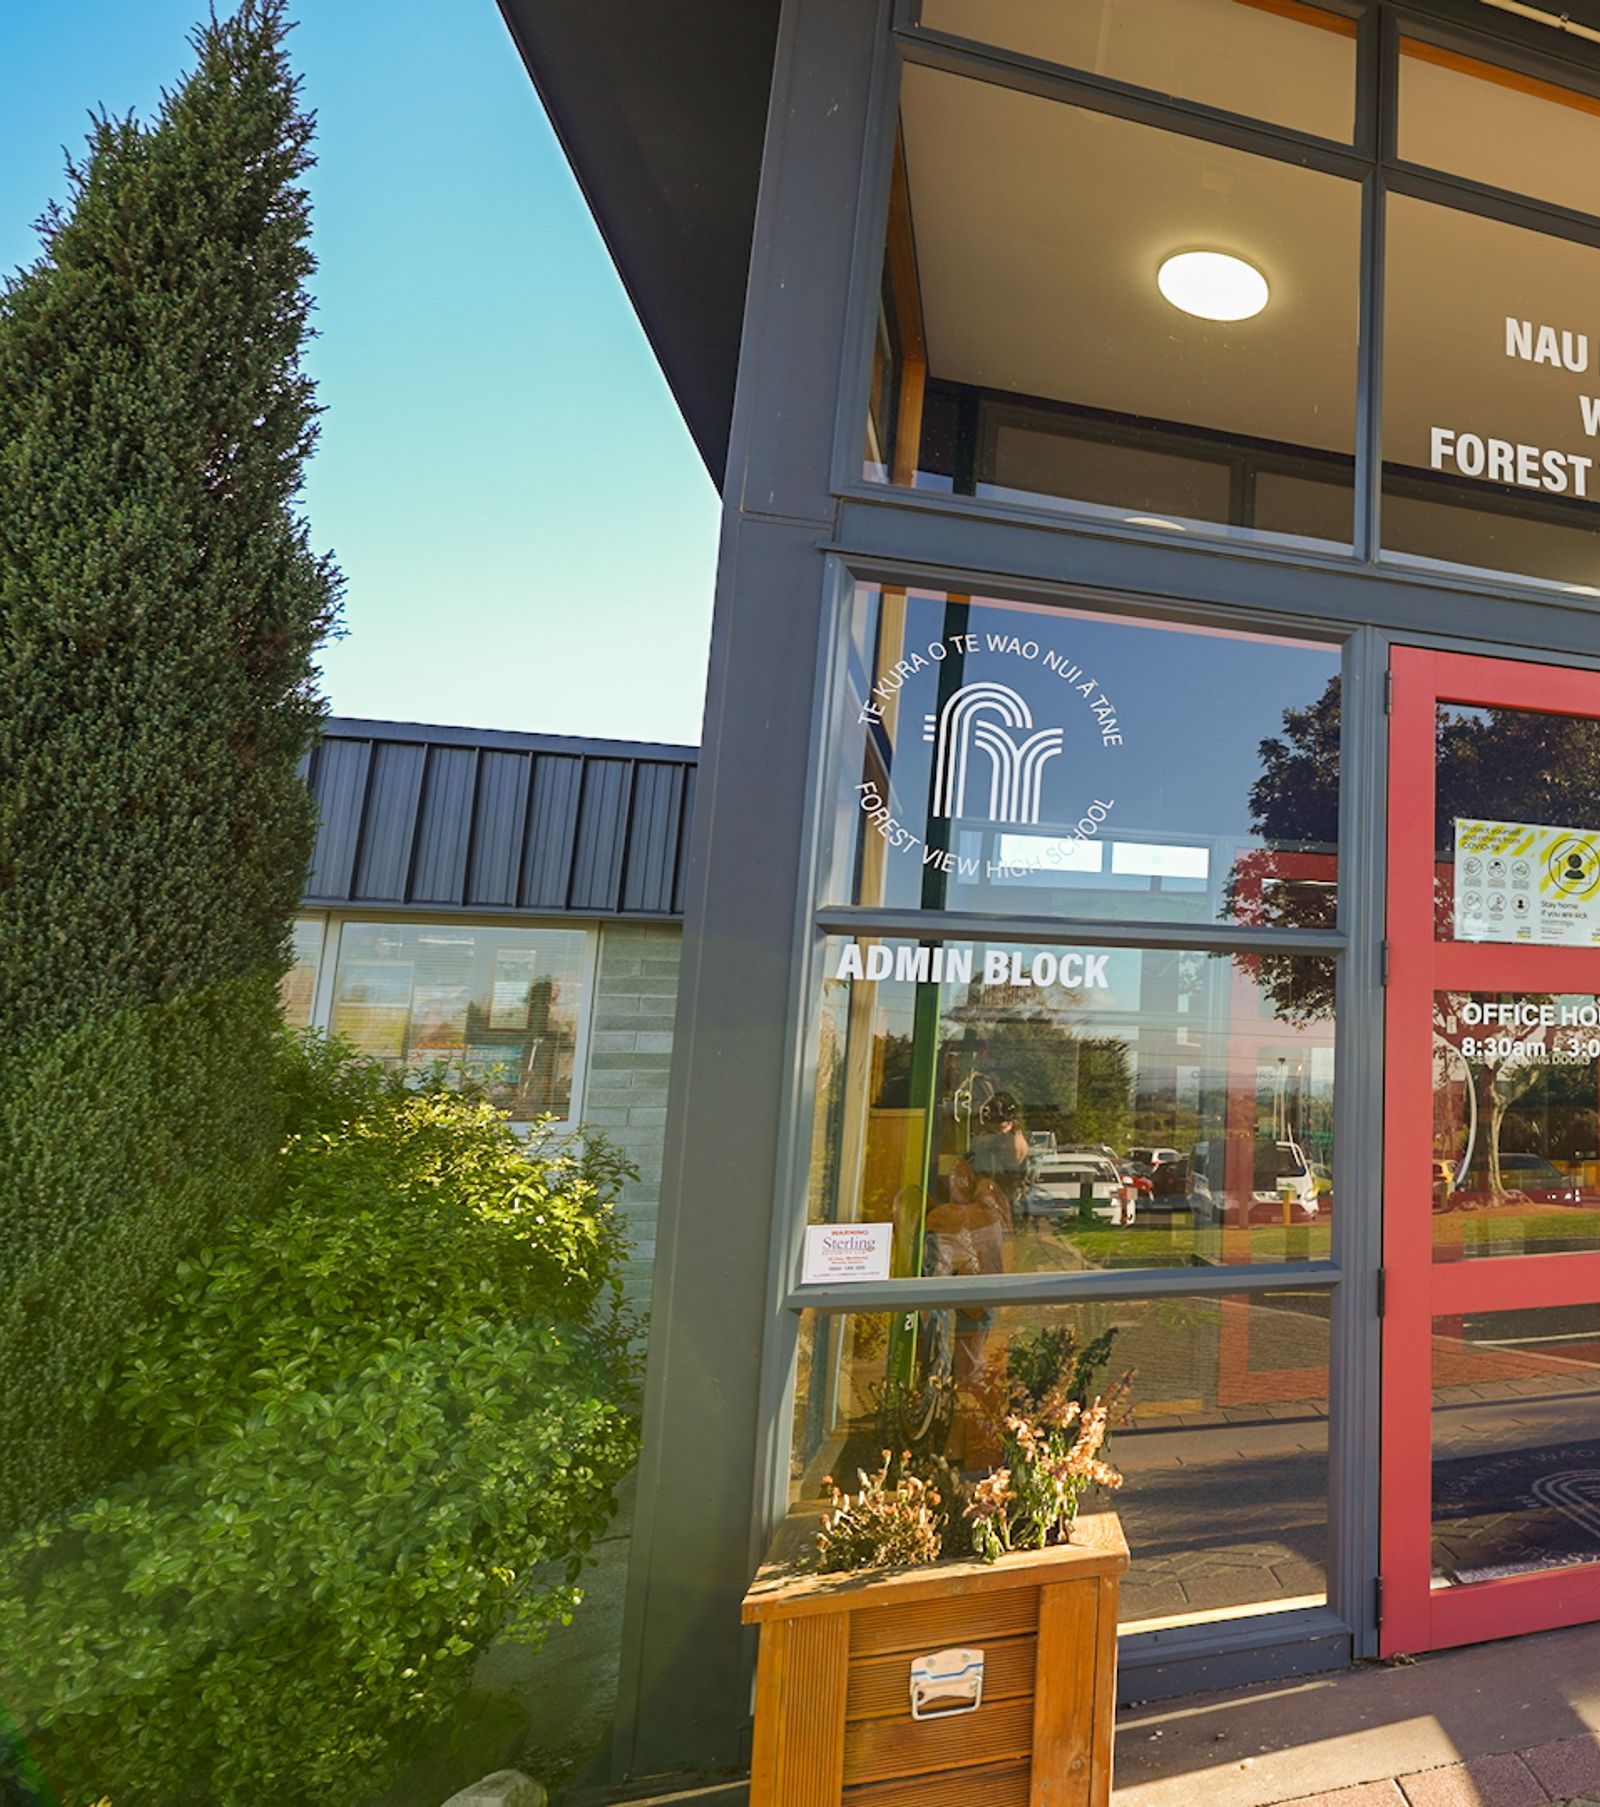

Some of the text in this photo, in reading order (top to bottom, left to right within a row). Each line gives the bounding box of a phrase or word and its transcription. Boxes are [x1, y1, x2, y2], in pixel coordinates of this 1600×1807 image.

[1506, 317, 1588, 373] NAU
[1430, 426, 1592, 497] FOREST
[858, 699, 886, 725] TE
[872, 652, 930, 700] KURA
[928, 641, 948, 661] O
[949, 634, 980, 654] TE
[986, 633, 1039, 660] WAO
[1042, 650, 1083, 684] NUI
[1090, 694, 1123, 747] TĀNE
[854, 781, 1115, 879] FOREST VIEW HIGH SCHOOL
[835, 943, 1111, 989] ADMIN BLOCK
[1461, 1003, 1555, 1027] OFFICE
[1461, 1036, 1546, 1057] 8:30am
[823, 1236, 876, 1252] Sterling
